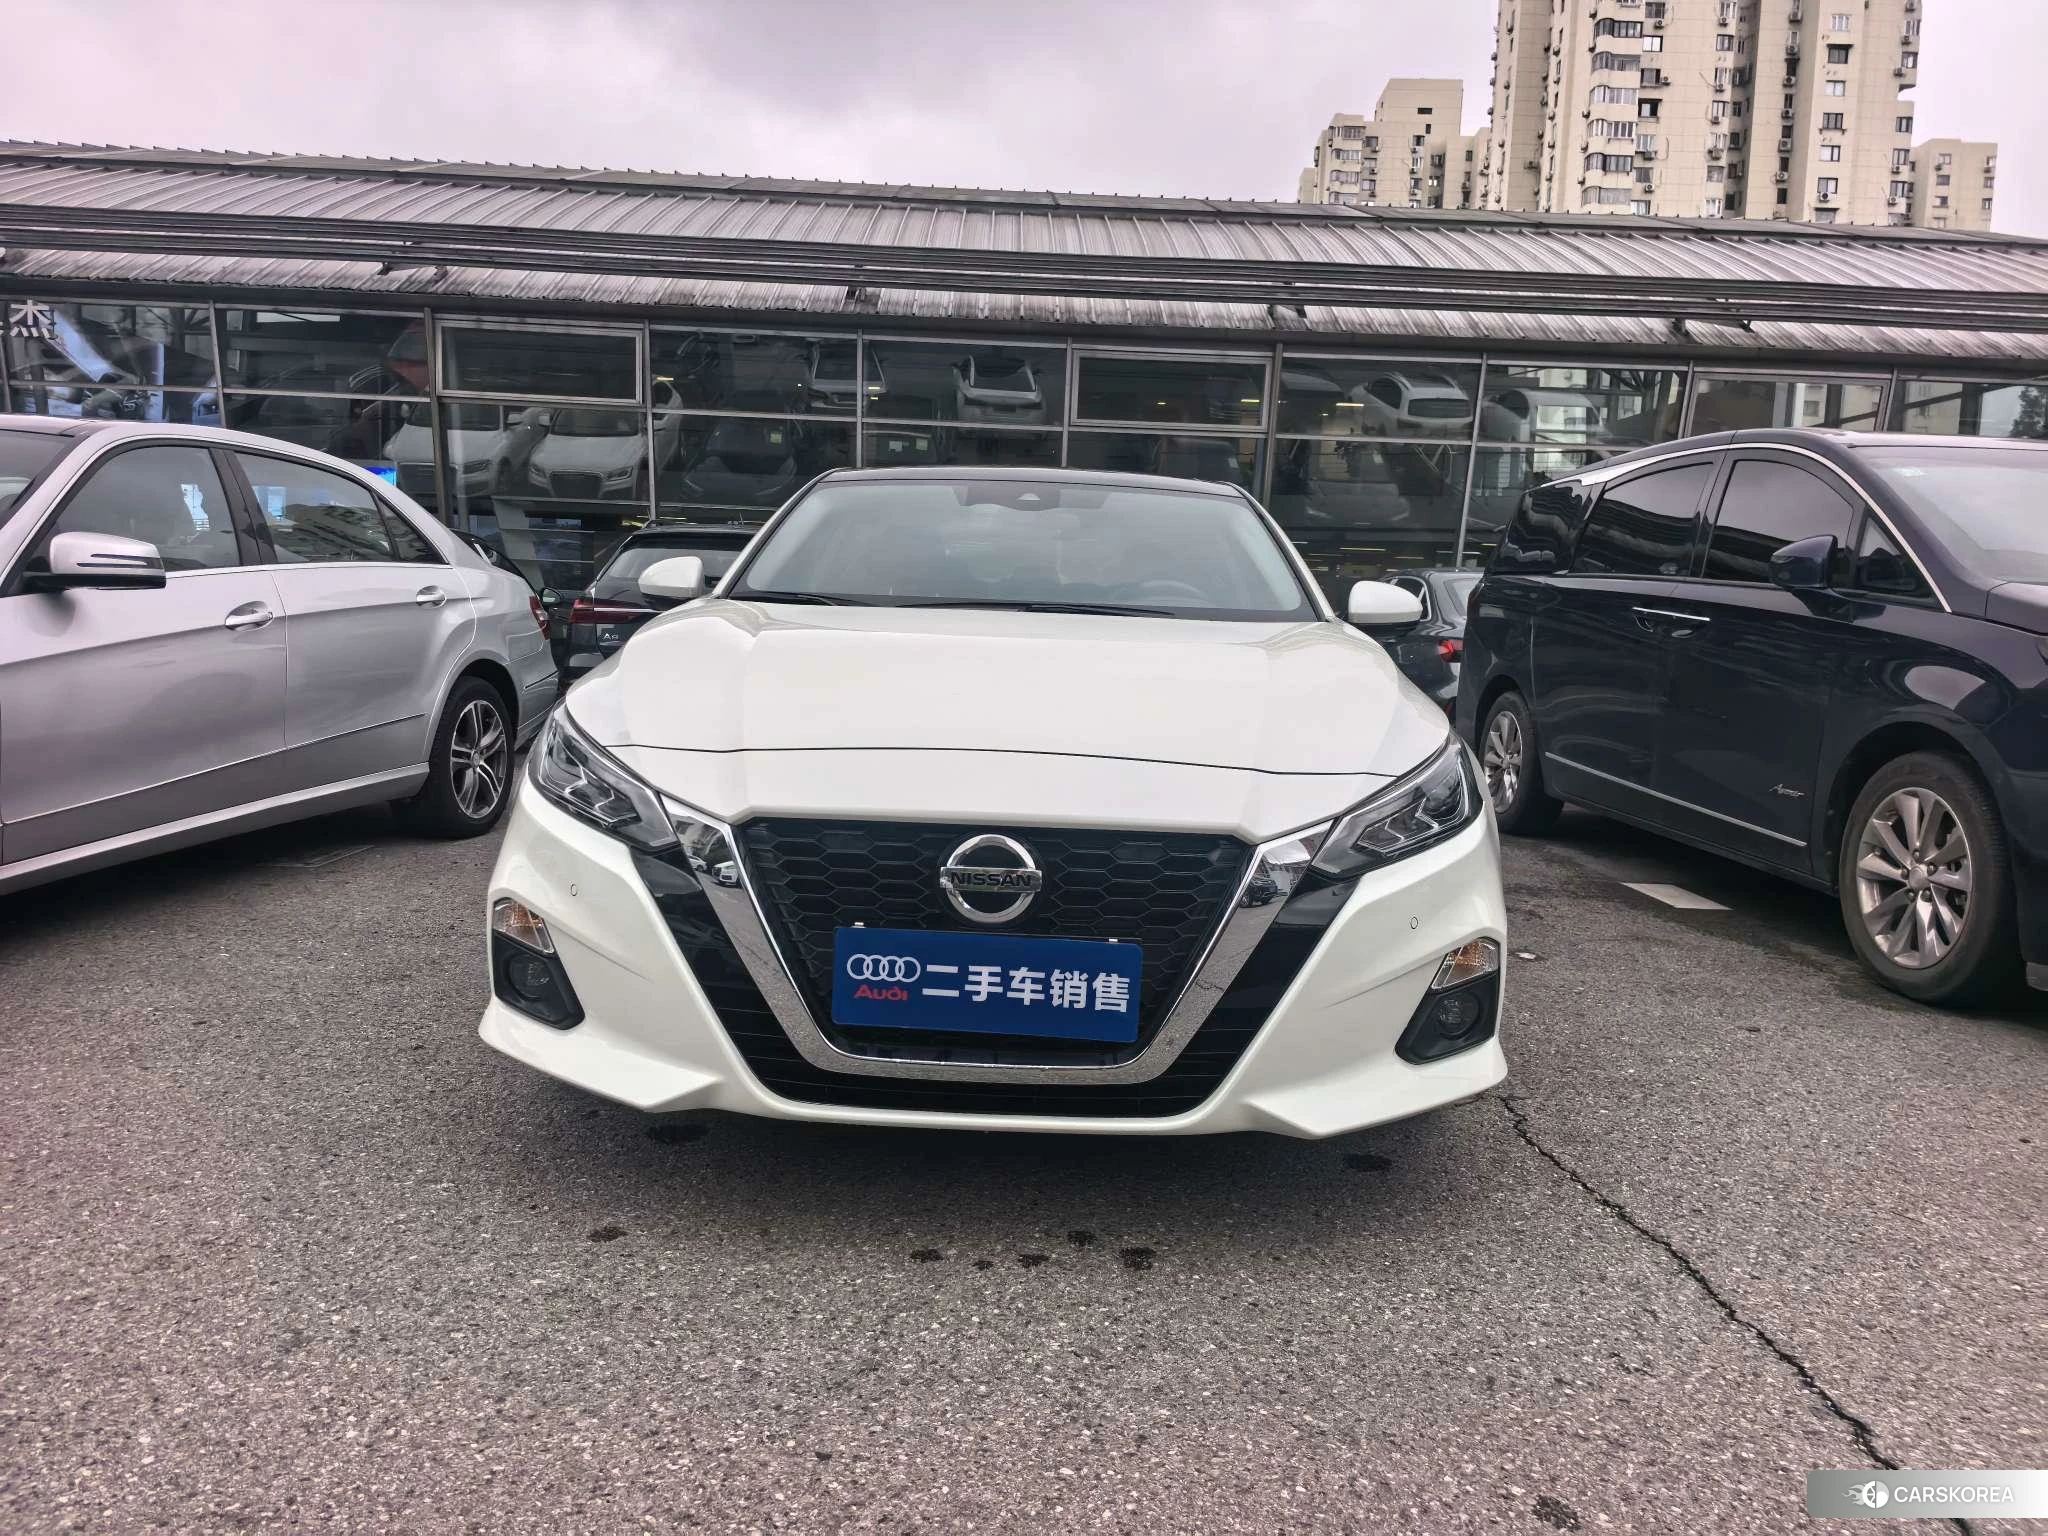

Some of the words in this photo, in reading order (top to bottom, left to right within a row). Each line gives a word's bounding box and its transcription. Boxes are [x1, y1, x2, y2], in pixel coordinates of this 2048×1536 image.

[0, 300, 52, 338] 杰
[950, 871, 1032, 888] NISSAN
[854, 984, 908, 1001] Audi
[922, 964, 1131, 1013] 二手车销售
